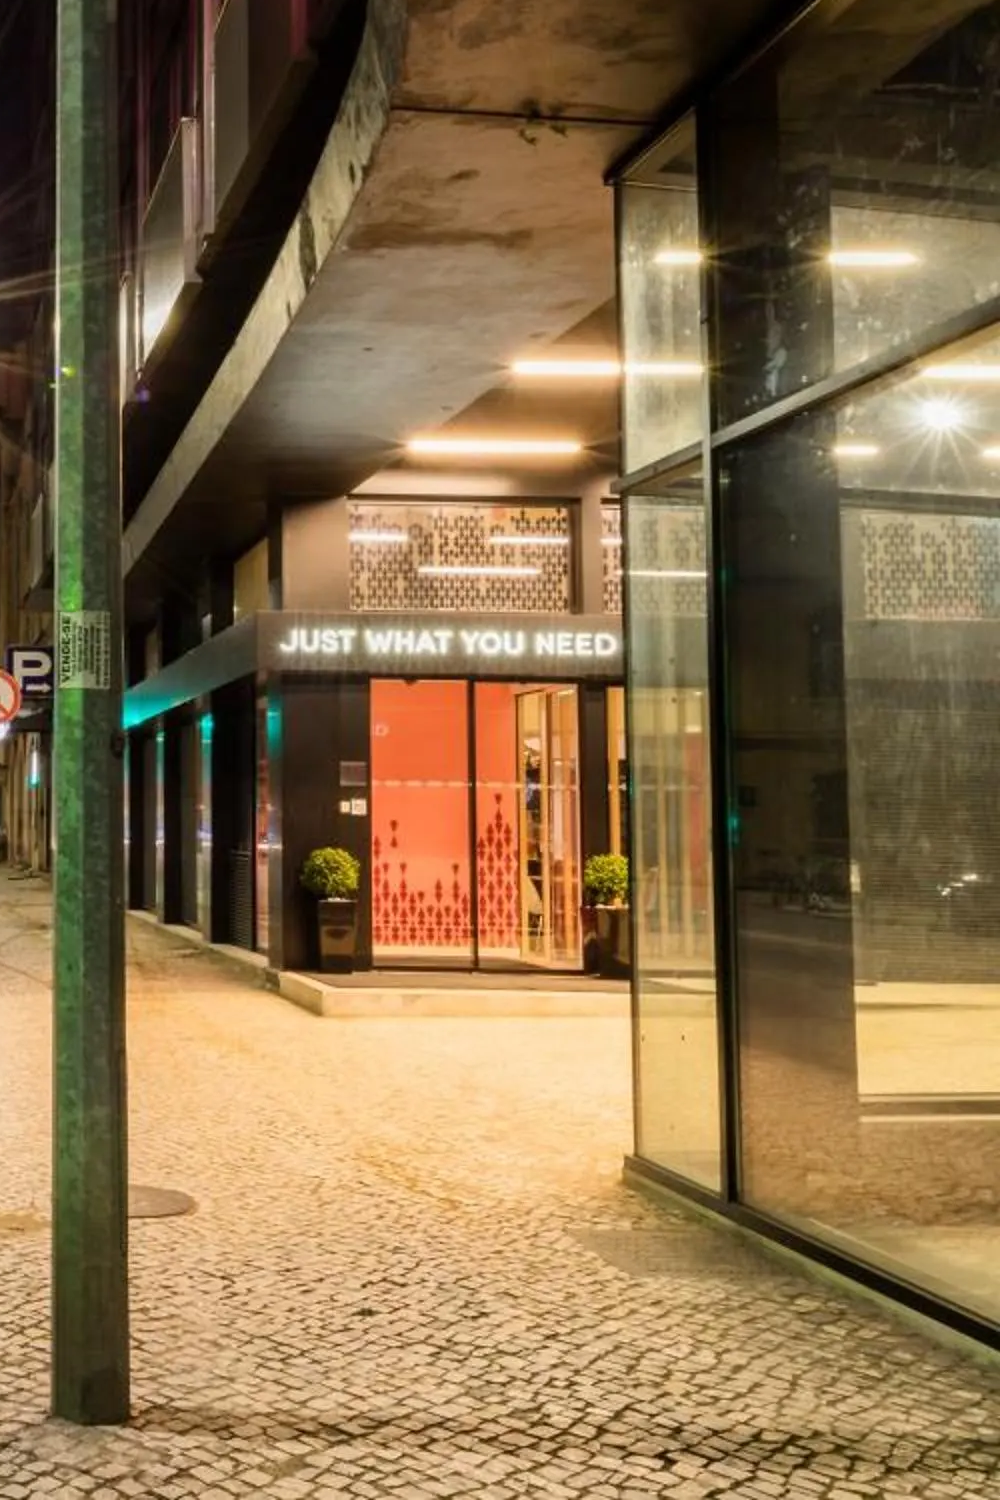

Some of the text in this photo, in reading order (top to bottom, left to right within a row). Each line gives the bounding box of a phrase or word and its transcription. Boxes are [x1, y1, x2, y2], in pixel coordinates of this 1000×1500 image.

[279, 628, 618, 658] JUST WHAT YOU NEED
[13, 651, 52, 689] P
